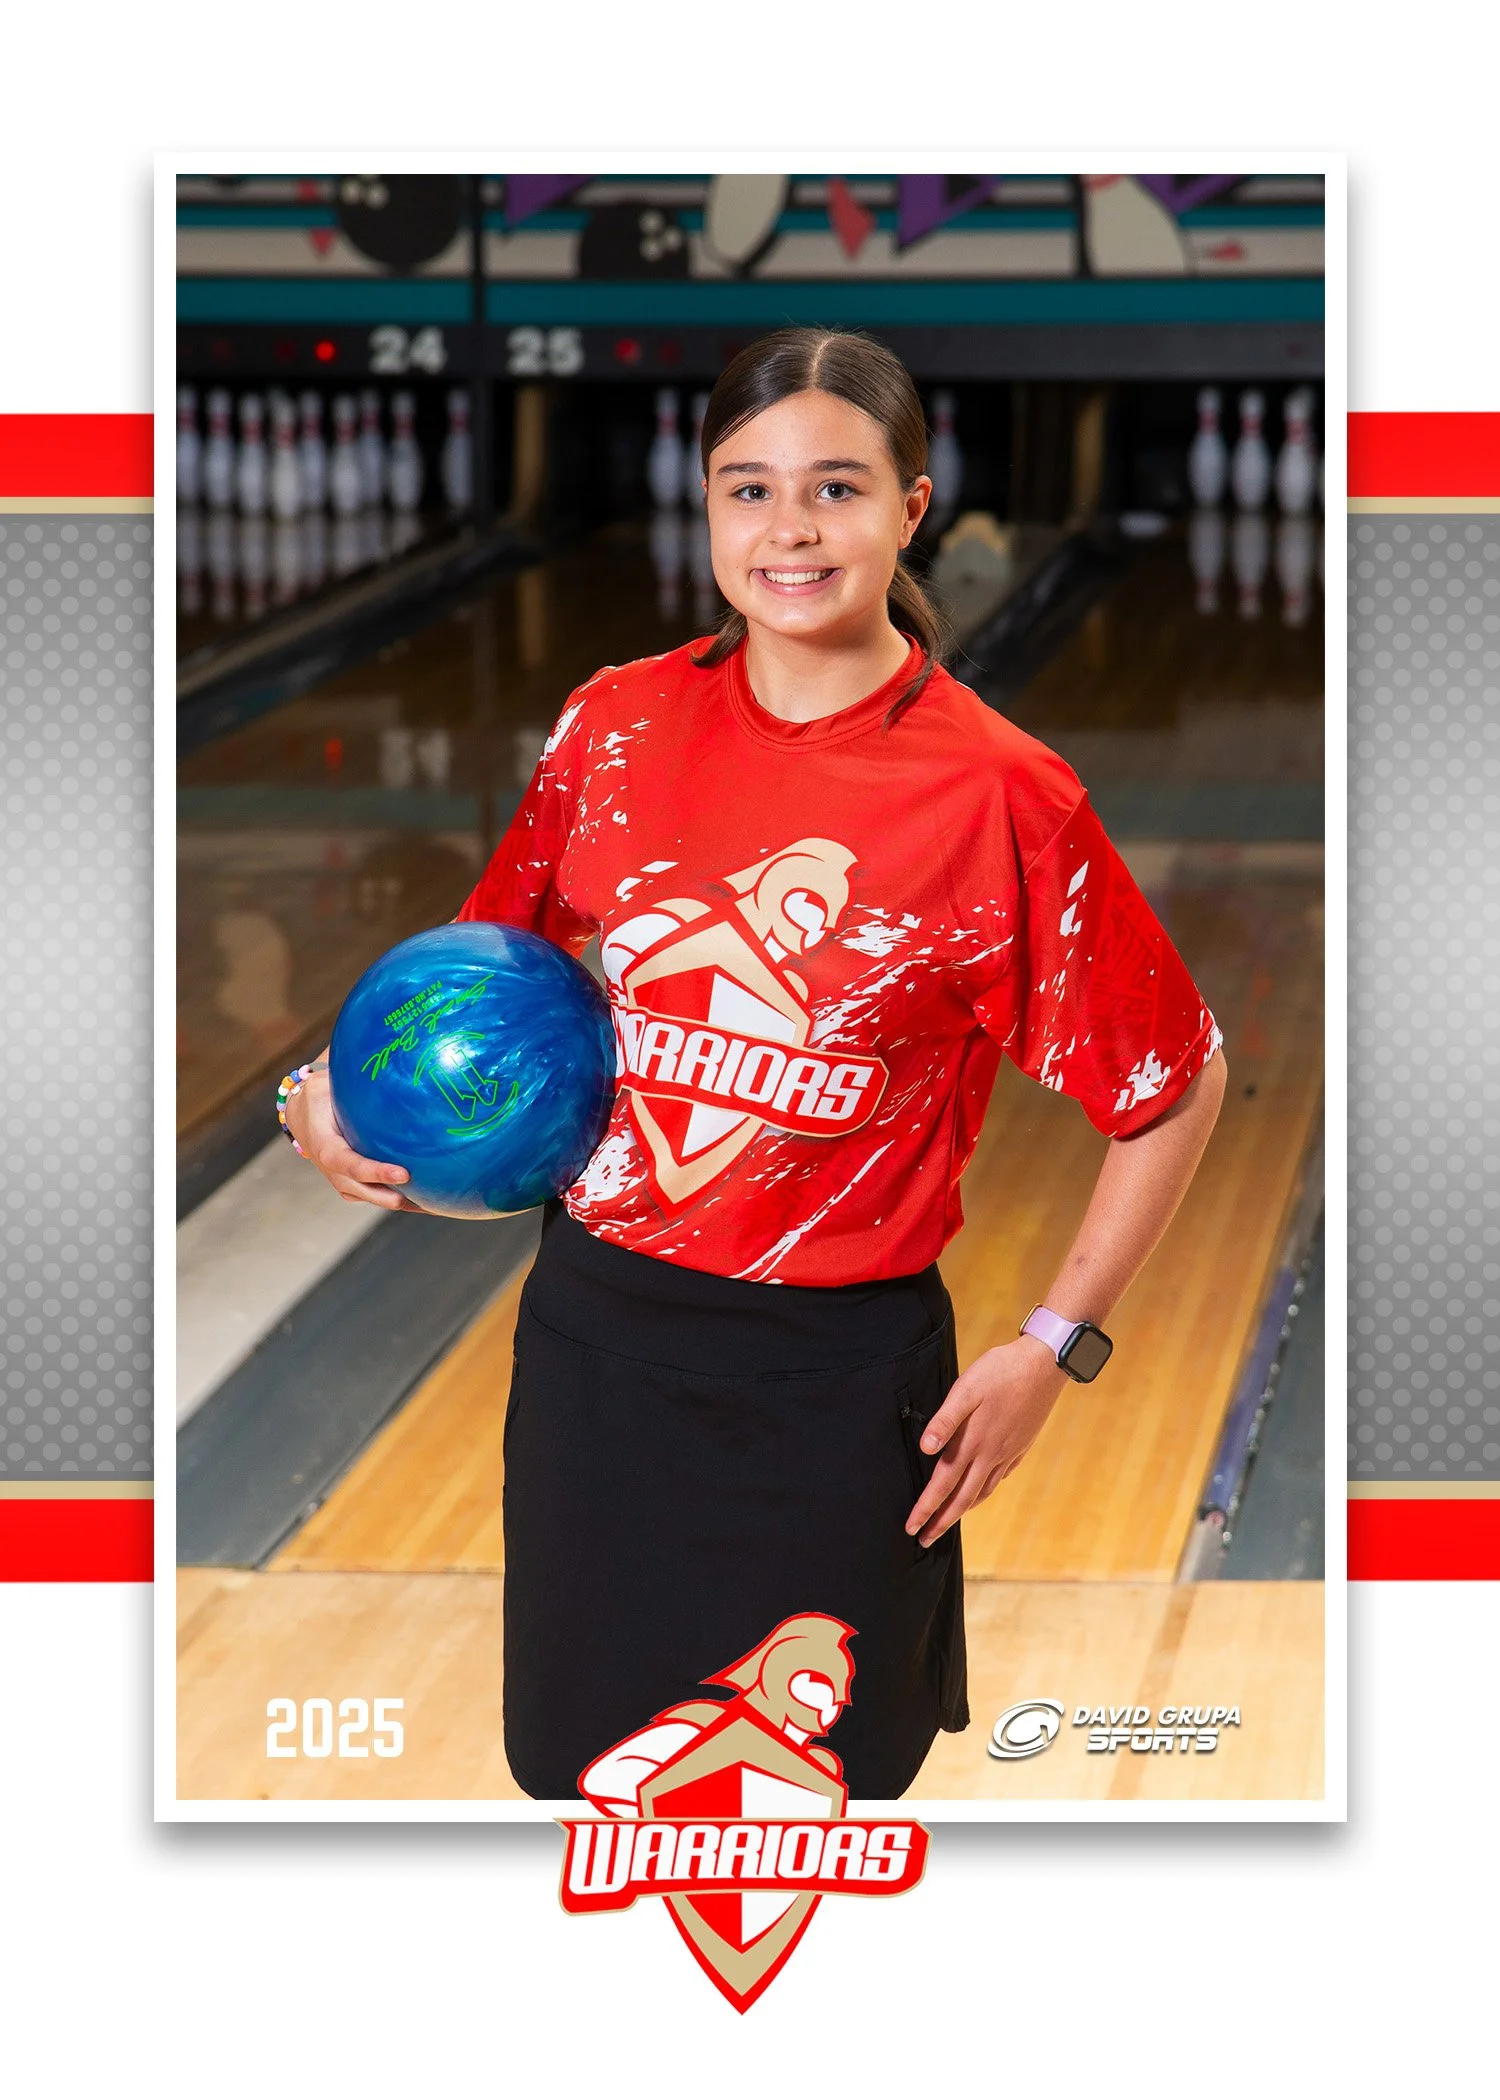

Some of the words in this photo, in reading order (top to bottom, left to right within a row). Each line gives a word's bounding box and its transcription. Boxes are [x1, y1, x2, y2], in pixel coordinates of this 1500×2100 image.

[368, 324, 449, 375] 24
[505, 325, 585, 376] 25
[361, 1025, 419, 1081] Ball
